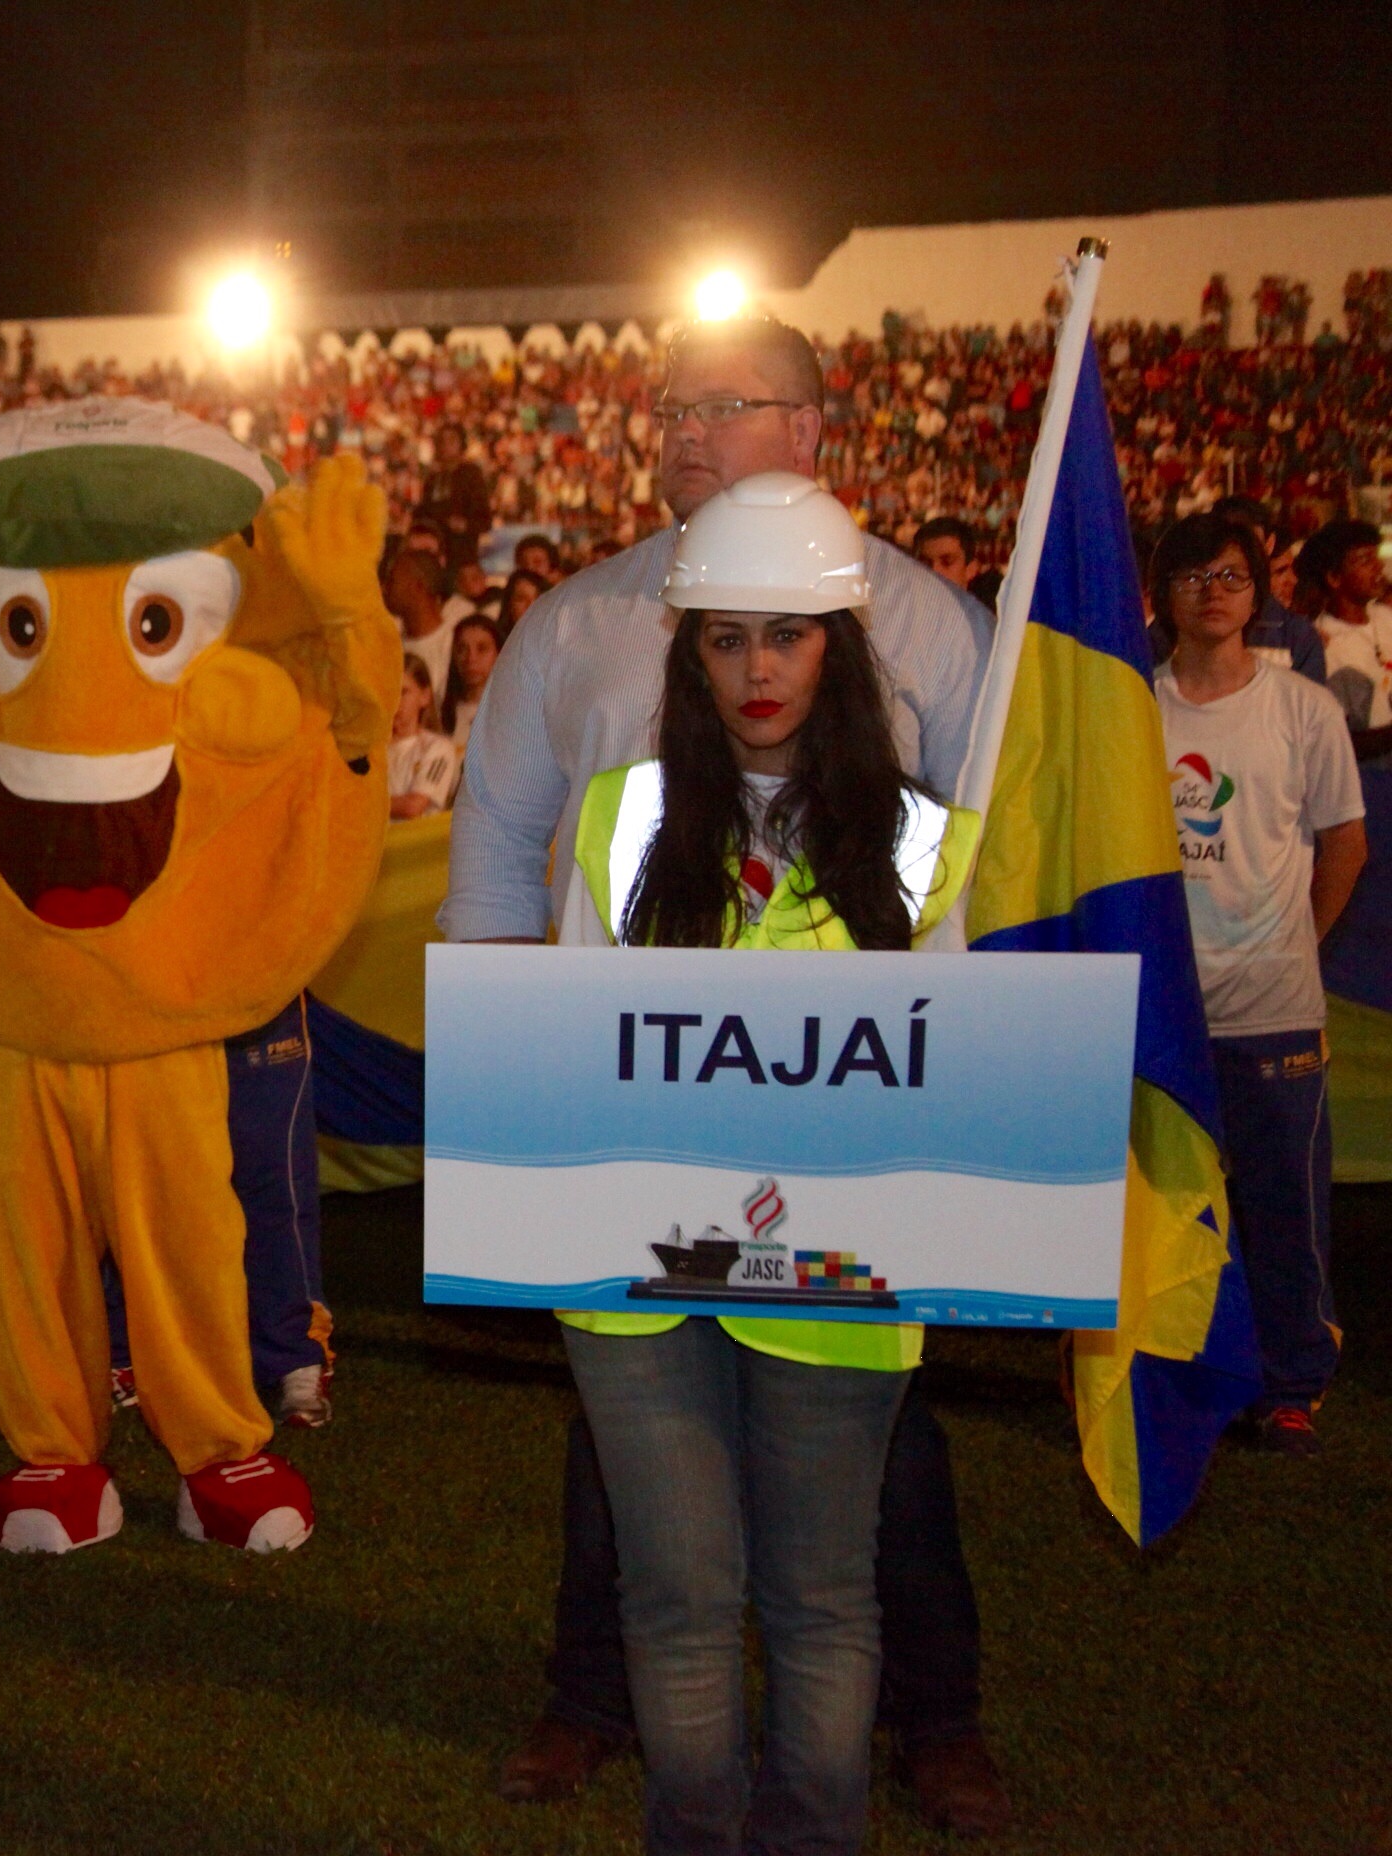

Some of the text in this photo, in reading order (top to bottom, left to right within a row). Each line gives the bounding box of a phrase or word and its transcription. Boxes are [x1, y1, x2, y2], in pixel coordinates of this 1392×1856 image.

[1178, 840, 1225, 862] AJAÍ
[619, 998, 932, 1088] ITAJAÍ
[741, 1257, 785, 1281] JASC
